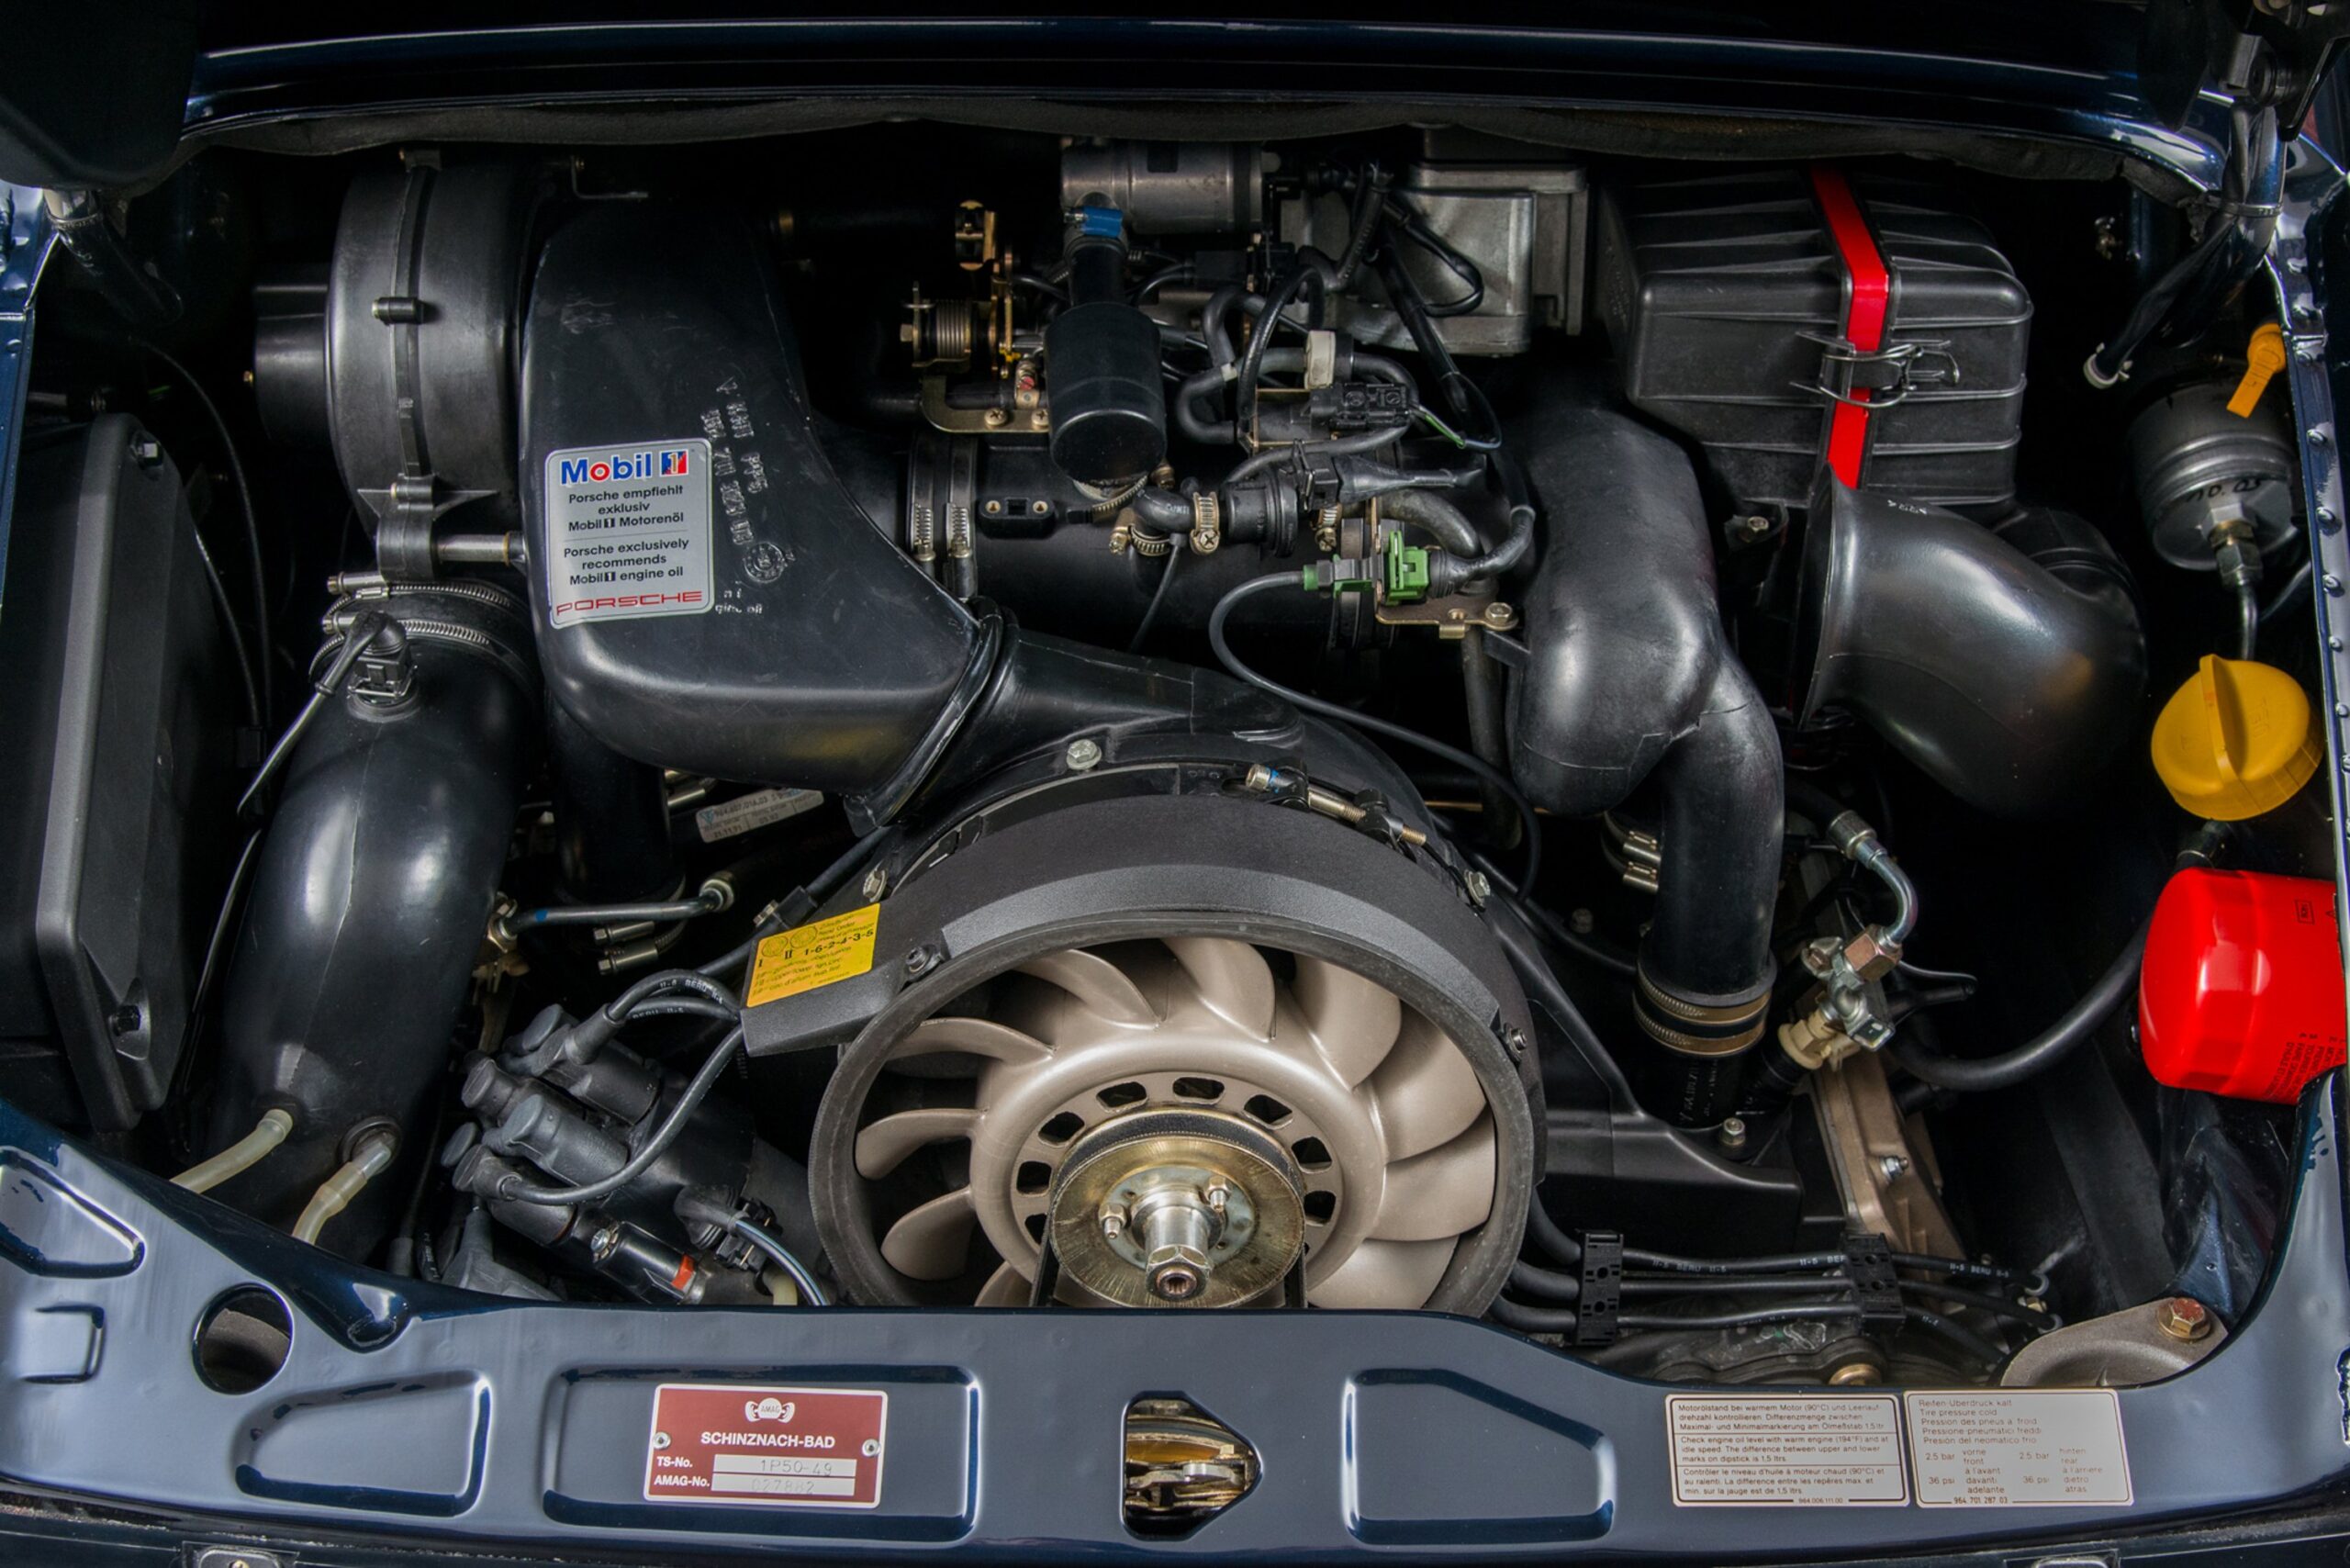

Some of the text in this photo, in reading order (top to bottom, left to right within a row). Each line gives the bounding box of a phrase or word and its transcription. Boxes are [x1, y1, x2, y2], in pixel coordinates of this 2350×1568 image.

[560, 454, 652, 486] Mobil
[569, 485, 683, 504] Porsche empfiehlt
[598, 501, 650, 515] exklusiv
[568, 512, 684, 532] Mobil 1 Motorenöl
[564, 538, 689, 558] Porsche exclusively
[581, 554, 666, 571] recommends
[569, 566, 684, 586] Mobil 1 engine oil
[556, 590, 703, 616] PORSCHE
[804, 928, 874, 956] 1-6-2-4-3-5
[760, 1406, 780, 1414] AMAG
[700, 1431, 835, 1449] SCHINZNACH-BAD
[656, 1456, 693, 1468] TS-No.
[1925, 1452, 1955, 1461] 2.5 bar
[2035, 1451, 2049, 1460] bar
[1683, 1468, 1720, 1476] Contrôler
[1721, 1468, 1729, 1476] le
[1731, 1468, 1757, 1476] niveau
[1759, 1468, 1785, 1476] d'huile
[1793, 1468, 1821, 1476] moteur
[654, 1475, 711, 1488] AMAG-No.
[1942, 1477, 1955, 1485] psi
